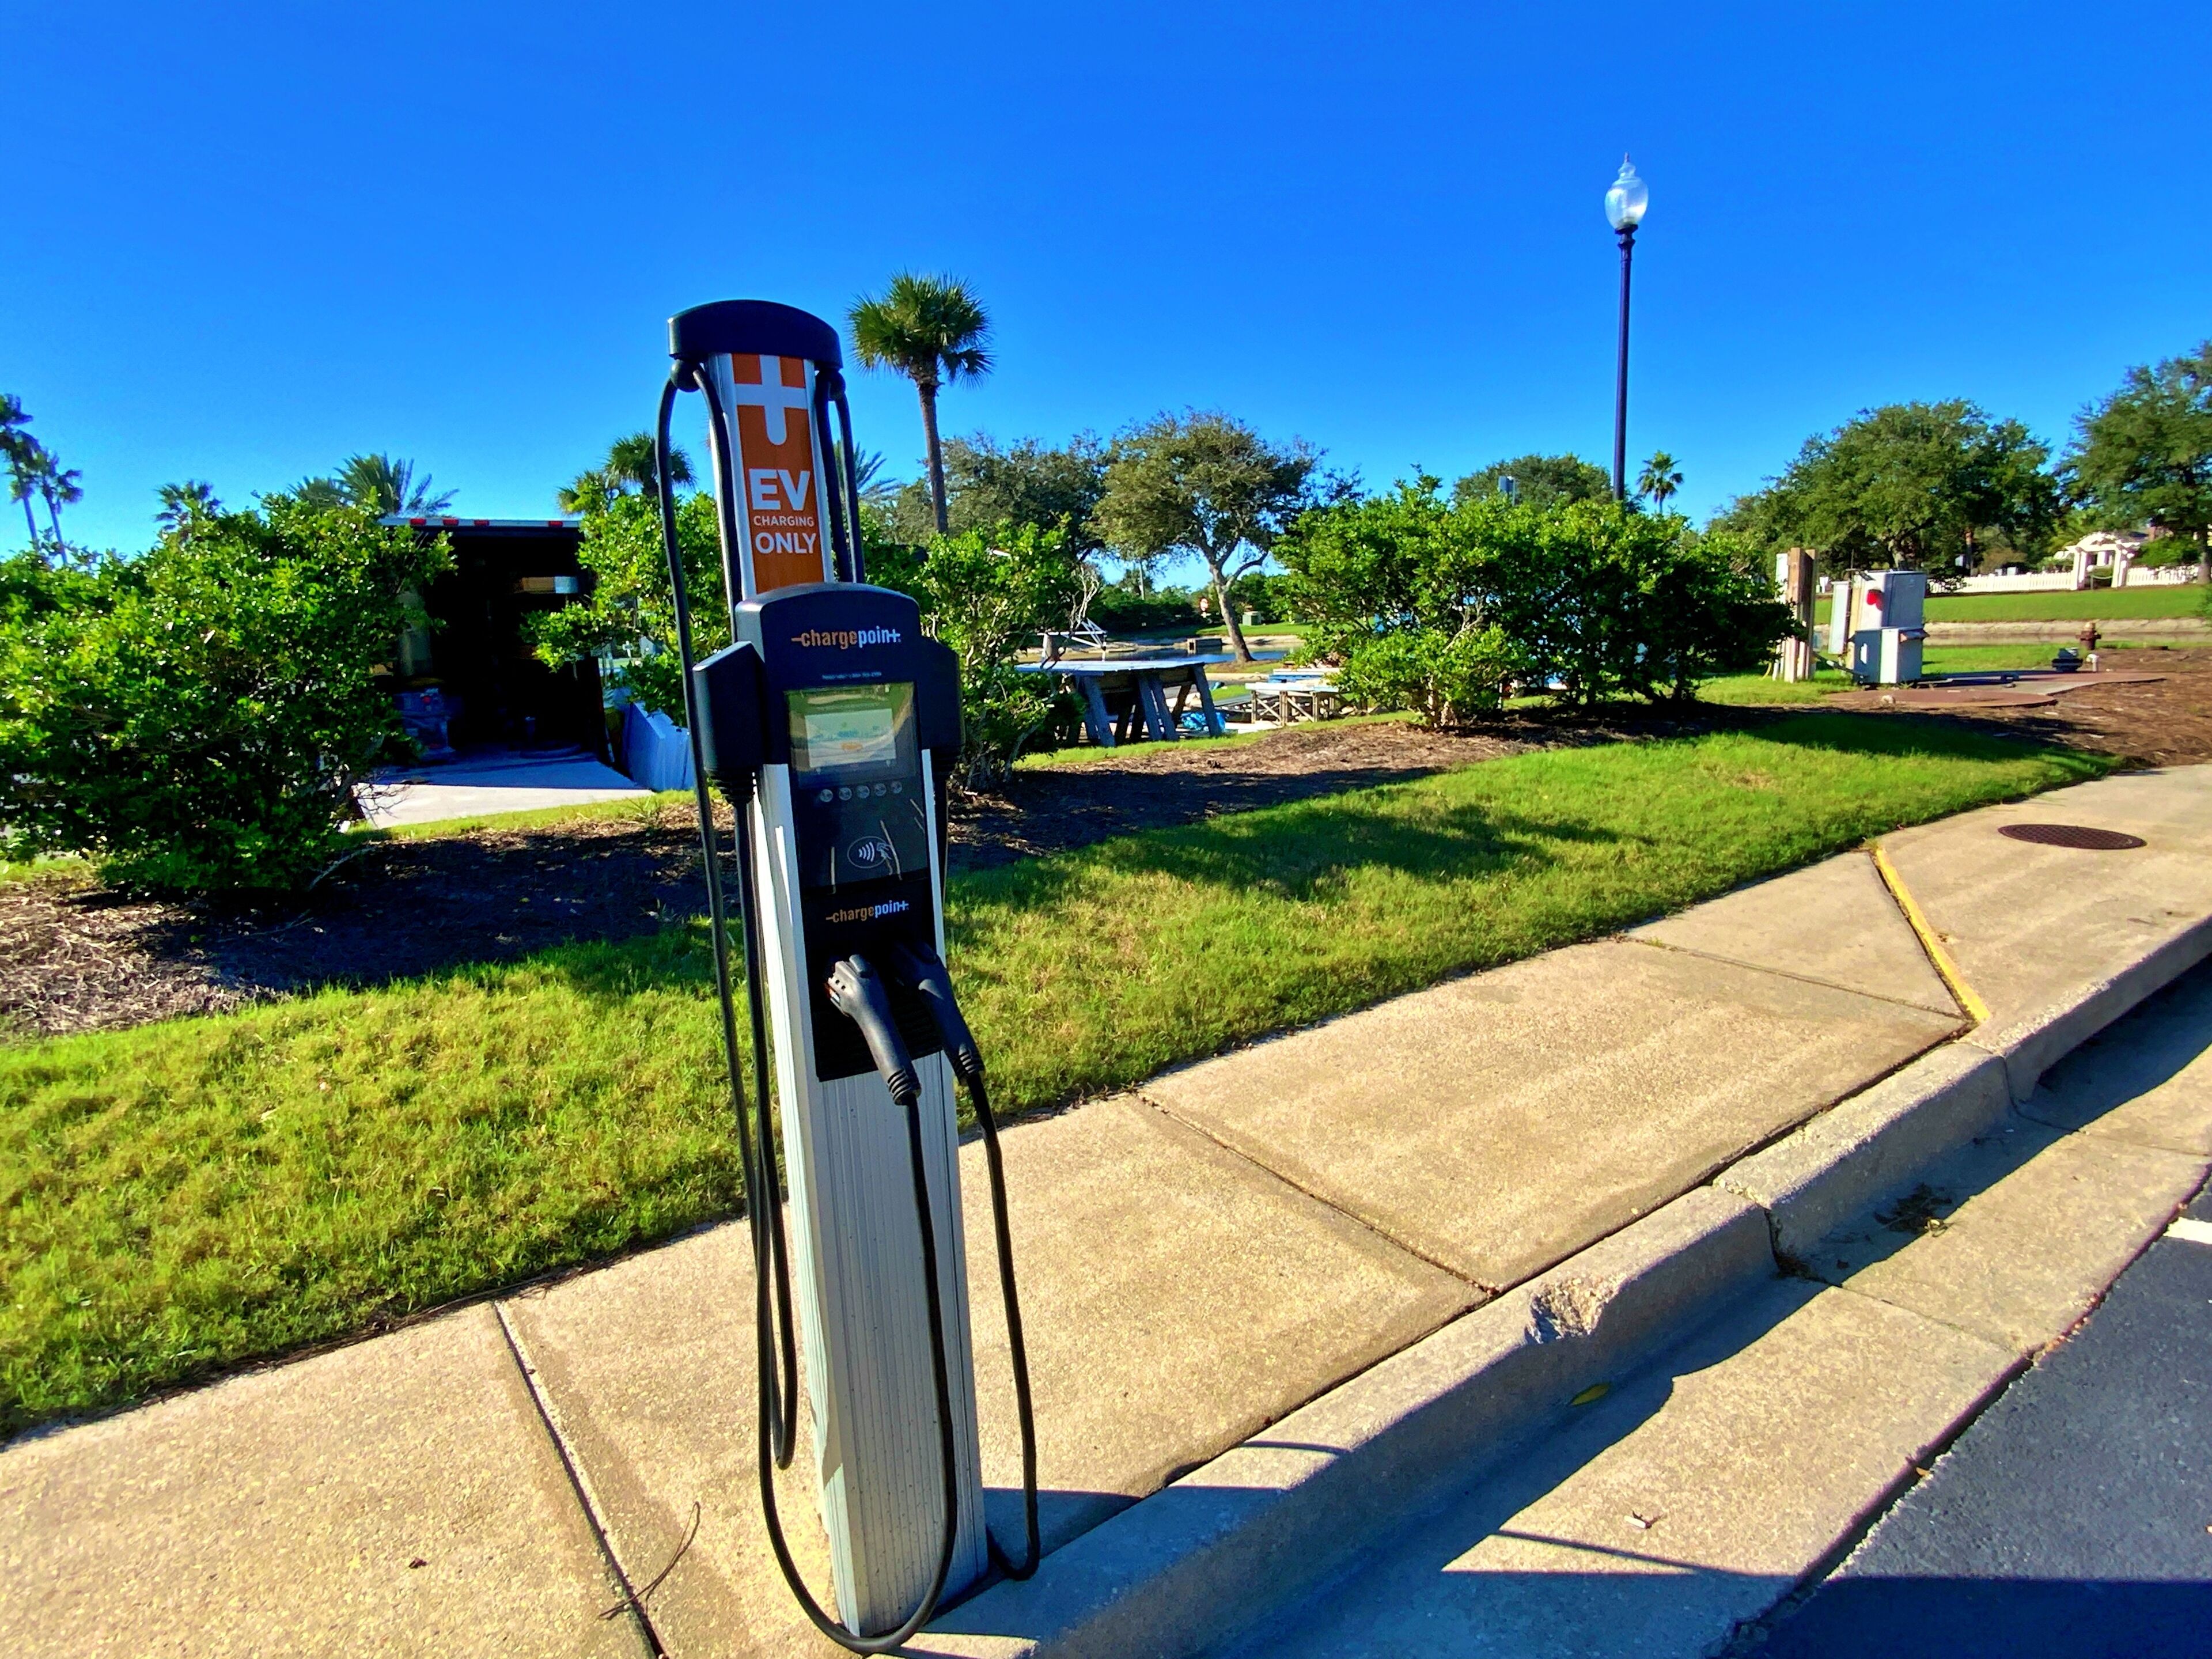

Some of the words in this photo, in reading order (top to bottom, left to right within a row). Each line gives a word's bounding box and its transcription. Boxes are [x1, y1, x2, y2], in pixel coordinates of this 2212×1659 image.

[749, 468, 810, 510] EV
[753, 516, 815, 527] CHARGING
[755, 532, 816, 554] ONLY
